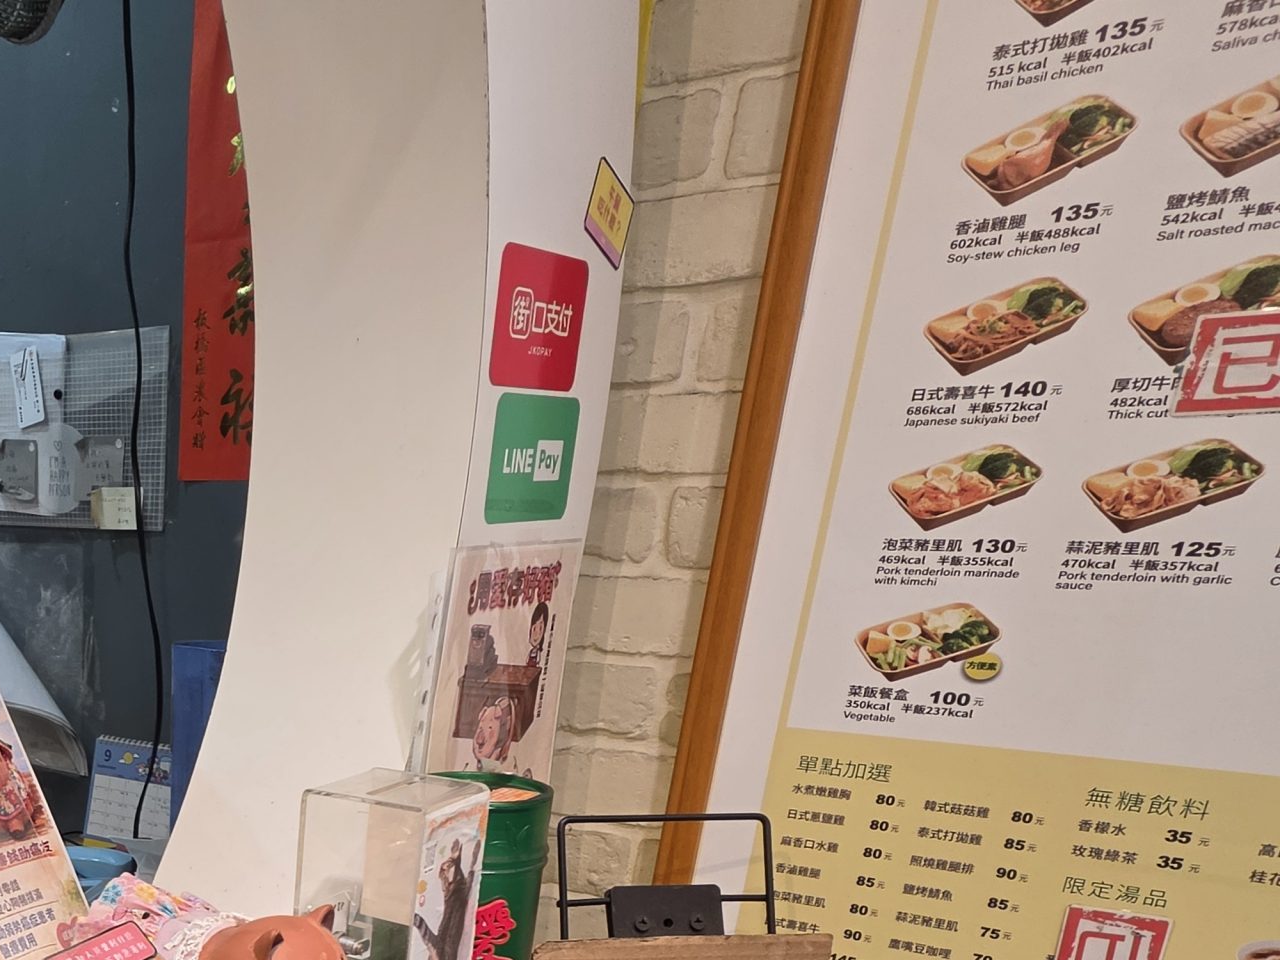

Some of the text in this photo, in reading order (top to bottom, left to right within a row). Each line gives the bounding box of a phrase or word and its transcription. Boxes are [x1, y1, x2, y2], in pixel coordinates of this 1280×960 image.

[988, 37, 1154, 78] 515 kcal 半飯402kcal
[986, 63, 1104, 91] Thai basil chicken
[1164, 186, 1251, 210] 鹽烤鯖魚
[954, 214, 1027, 236] 香滷雞腿
[1160, 208, 1223, 226] 542kcal
[949, 224, 1101, 250] 602kcal 半飯488kcal
[1156, 222, 1245, 241] Salt roasted
[946, 241, 1081, 264] Soy-stew chicken leg
[513, 292, 573, 337] 街口支付
[910, 383, 995, 403] 日式壽喜牛
[1110, 395, 1168, 407] 482kcal
[905, 400, 1048, 416] 686kcal 半飯572kcal
[1108, 409, 1168, 419] Thick cut
[904, 413, 1040, 428] Japanese sukiyaki beef
[503, 447, 559, 474] LINE Pay
[881, 537, 963, 555] 泡菜豬里肌
[1065, 540, 1160, 557] 蒜泥豬里肌
[878, 555, 1014, 568] 469kcal 半飯355kcal
[1060, 558, 1219, 573] 470kcal 半飯357kcal
[874, 576, 938, 587] with kimchi
[876, 566, 1020, 579] Pork tenderloin marinade
[1058, 571, 1233, 587] Pork tenderloin with garlic
[1055, 581, 1093, 591] sauce
[847, 684, 910, 702] 菜飯餐盒
[843, 711, 897, 724] Vegetable
[845, 700, 975, 719] 350kcal 半飯237kcal
[795, 755, 893, 783] 單點加選
[923, 799, 991, 819] 韓式菇菇雞
[1084, 787, 1210, 821] 無糖飲料
[780, 835, 840, 853] 麻香口水雞
[1071, 844, 1139, 866] 玫瑰綠茶
[775, 862, 822, 880] 香滷雞腿
[909, 854, 975, 875] 照燒雞腿排
[1062, 876, 1168, 909] 限定湯品
[765, 917, 820, 934] 式壽喜牛
[895, 911, 959, 933] 蒜泥豬里肌
